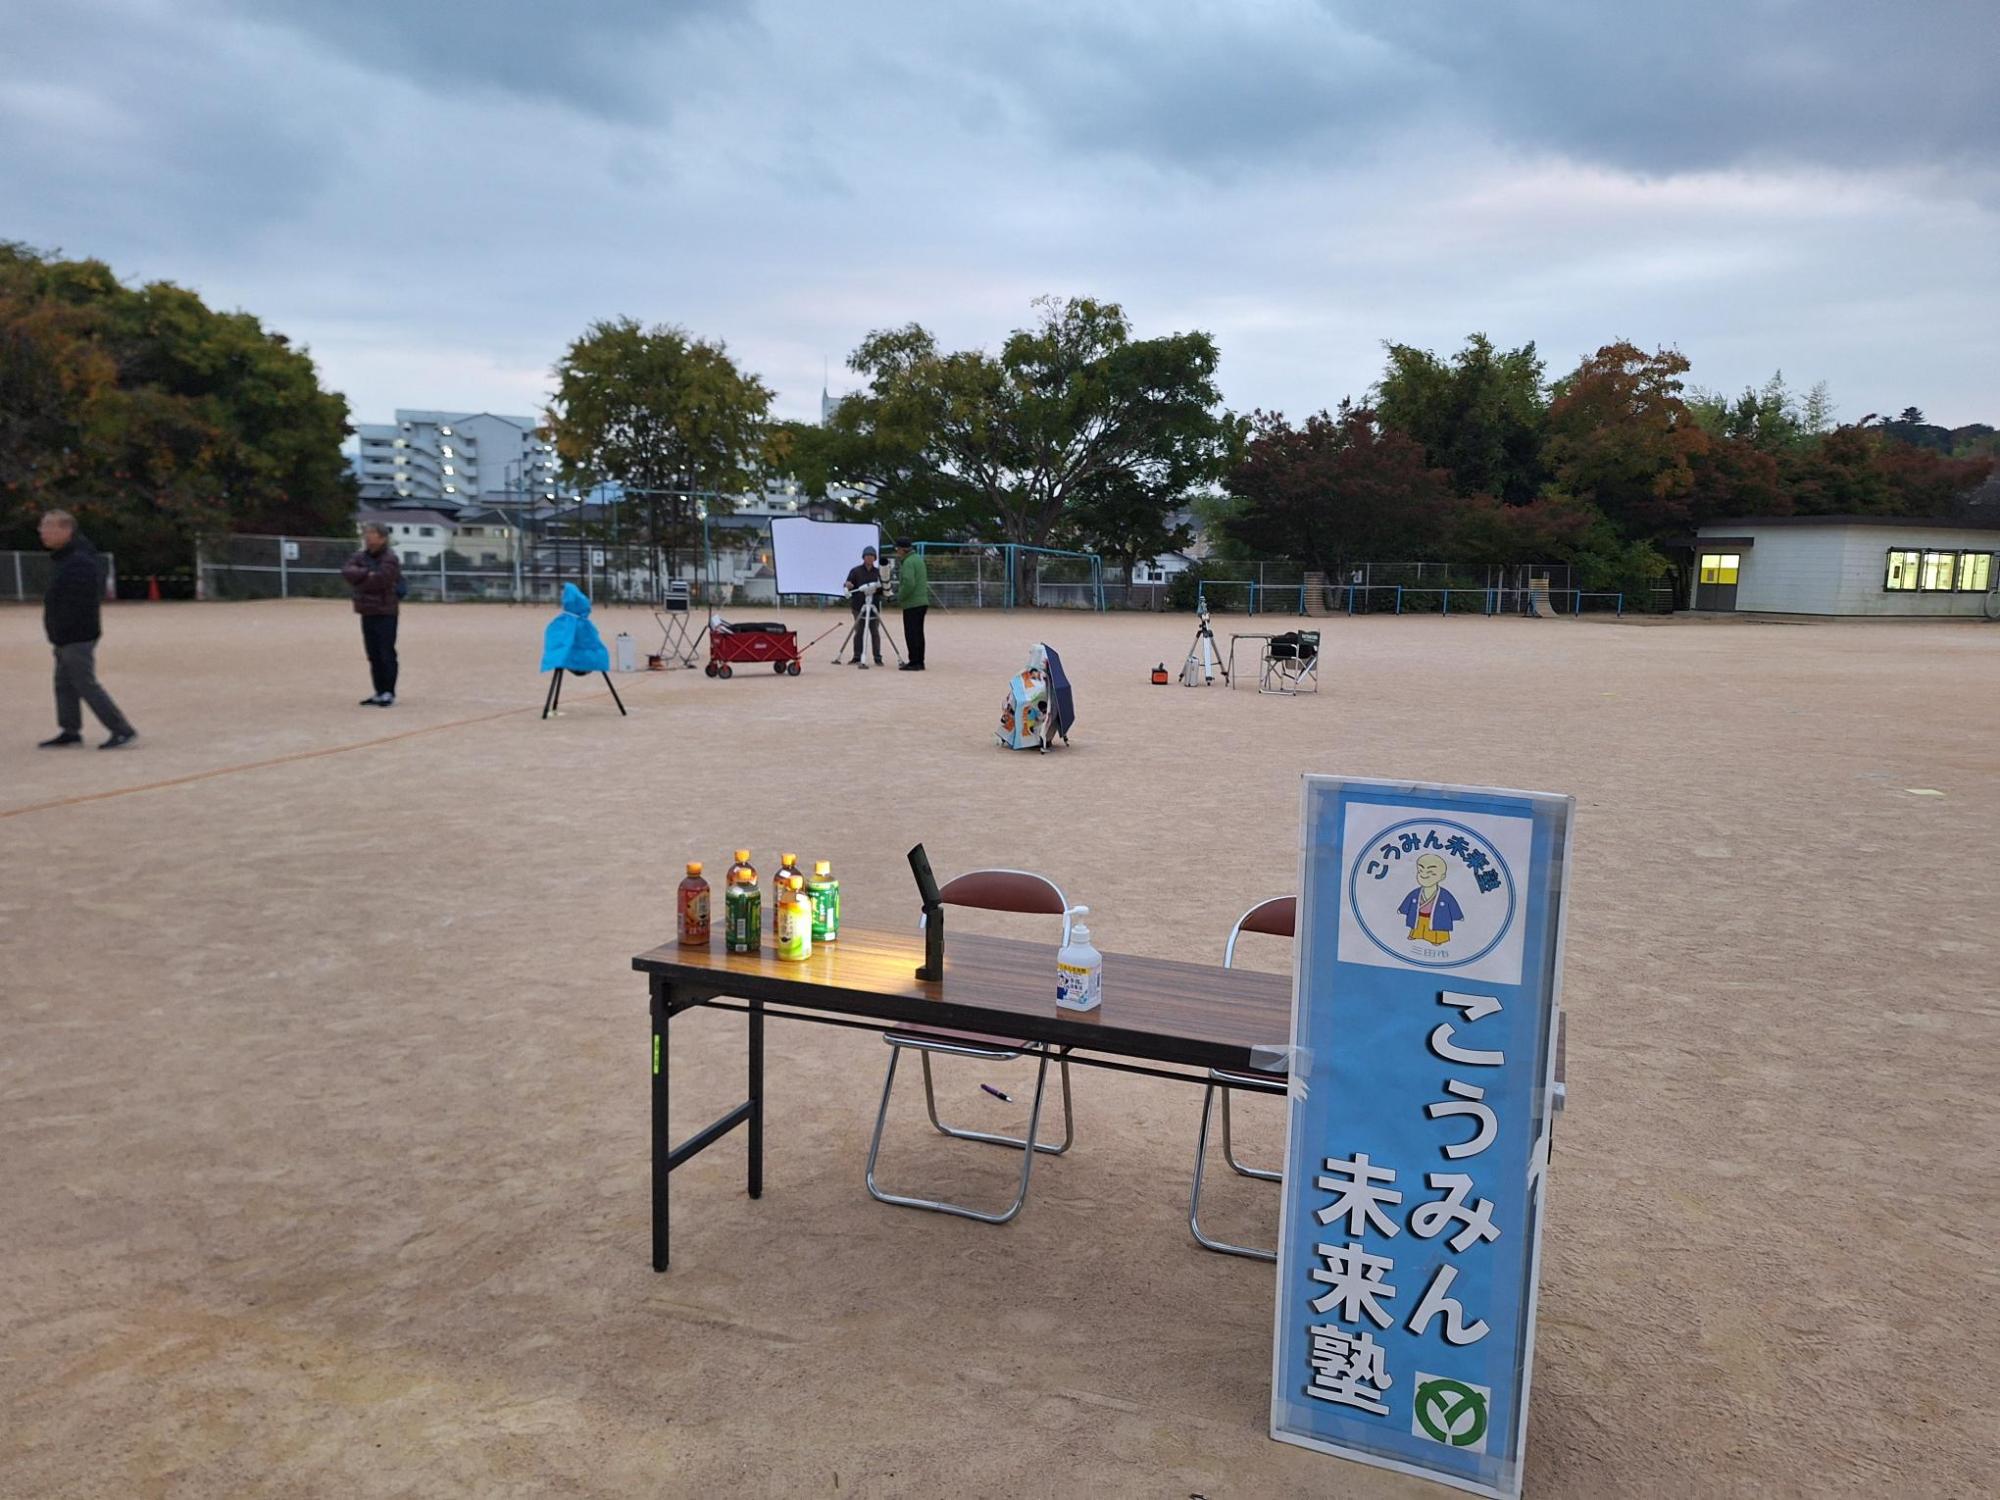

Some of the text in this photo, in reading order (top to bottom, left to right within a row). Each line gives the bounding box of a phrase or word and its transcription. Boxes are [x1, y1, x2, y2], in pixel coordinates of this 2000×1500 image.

[1366, 829, 1502, 894] こうみん未来塾
[1306, 1152, 1403, 1416] 未来塾
[1408, 990, 1505, 1346] こうみん
